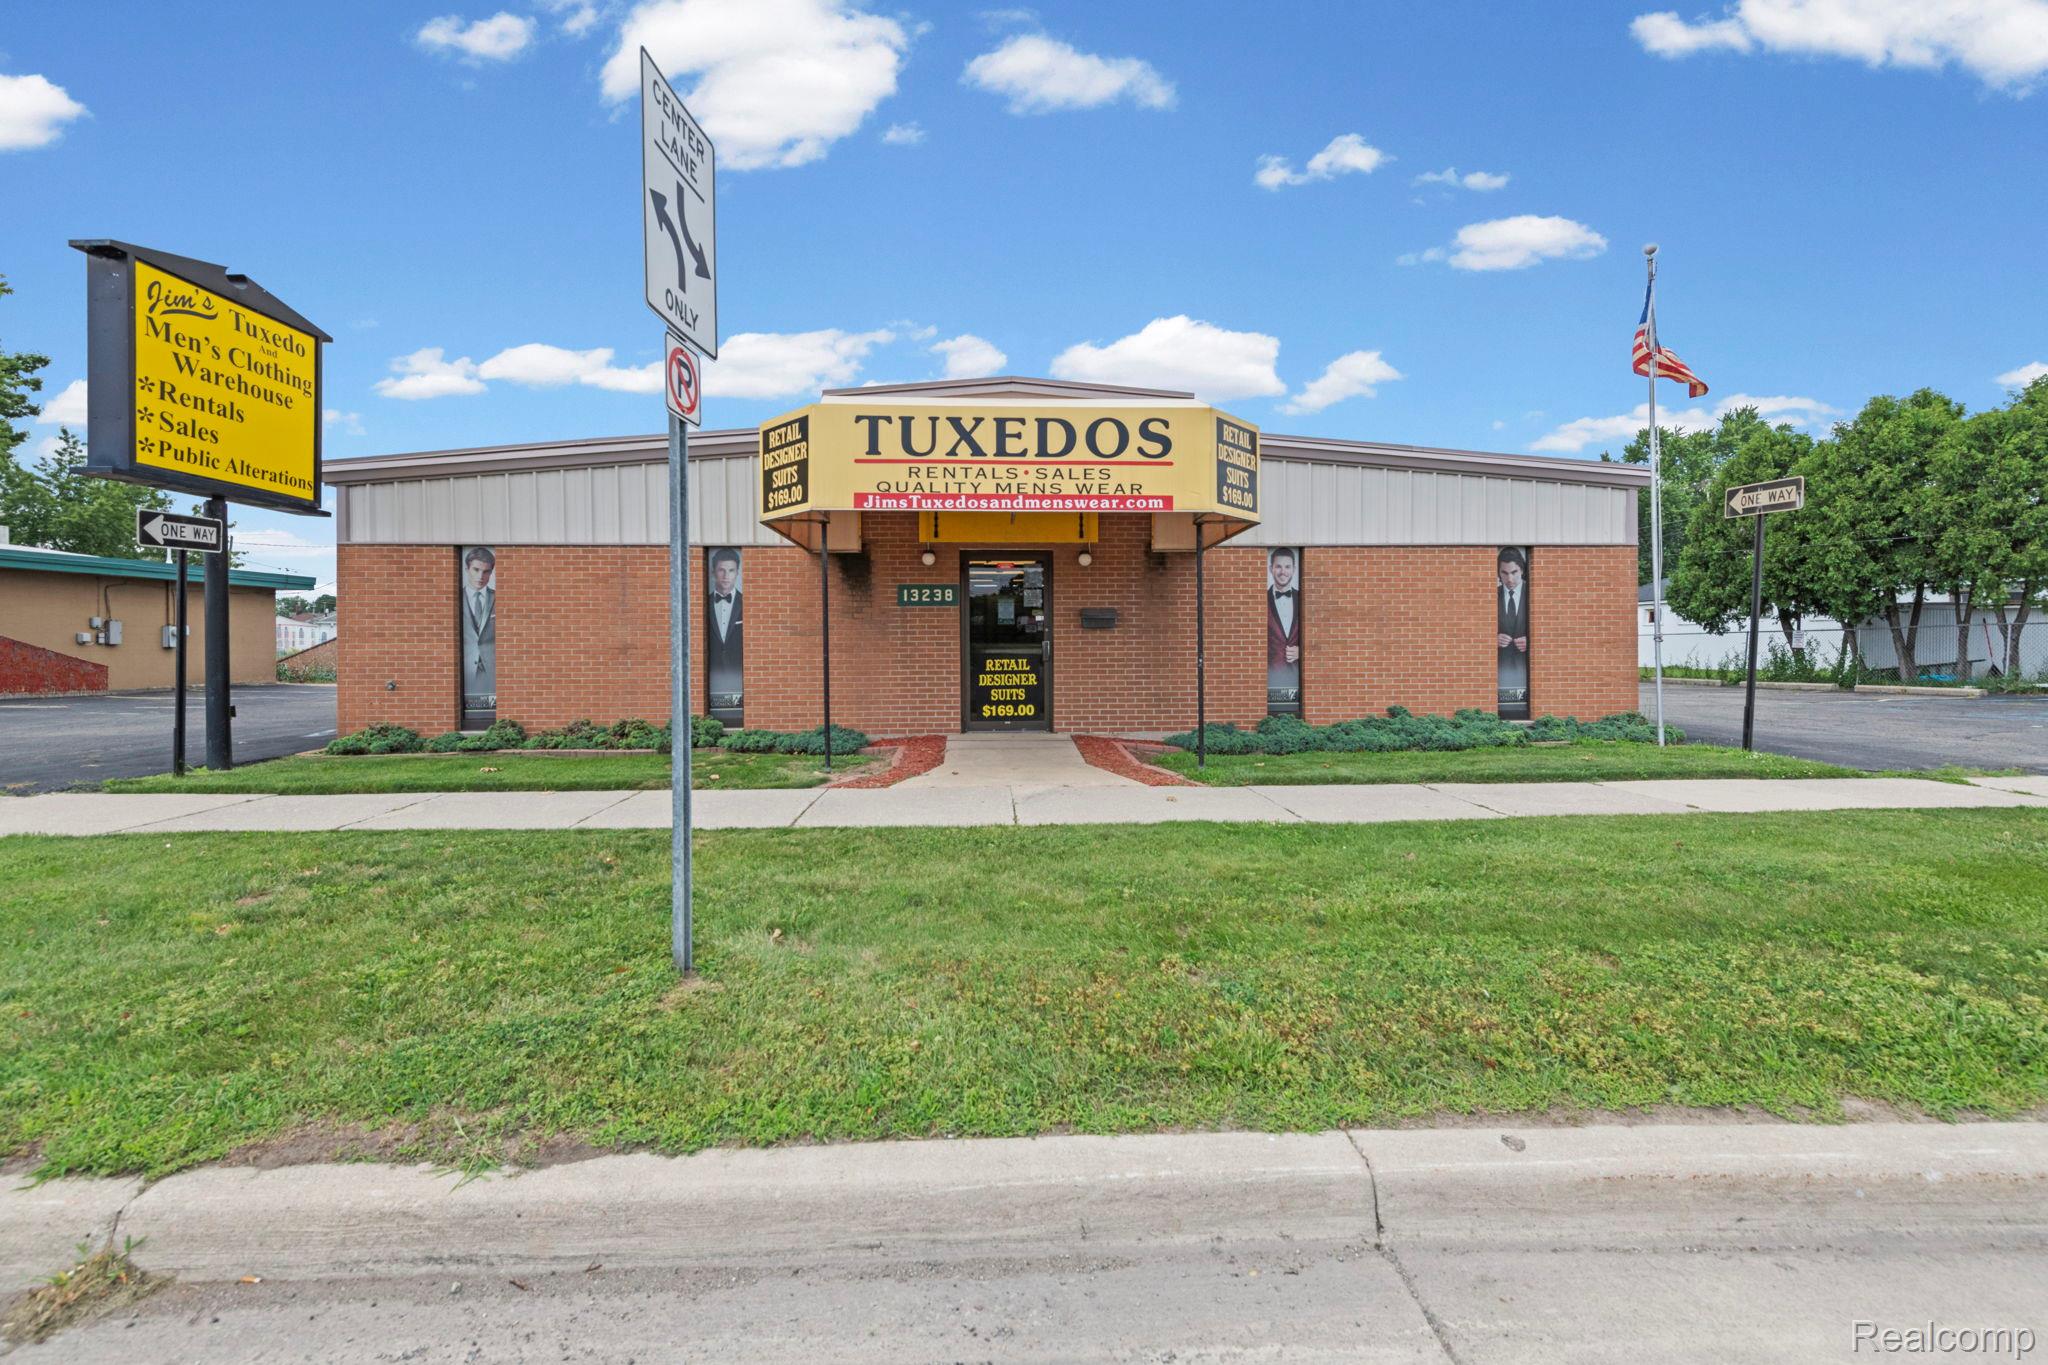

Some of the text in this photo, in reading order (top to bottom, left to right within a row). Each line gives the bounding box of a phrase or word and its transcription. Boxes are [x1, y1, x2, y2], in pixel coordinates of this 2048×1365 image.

[653, 79, 704, 164] CENTER
[661, 119, 698, 184] LANE
[147, 280, 306, 358] Jim's Tuxedo
[665, 288, 699, 332] ONLY
[145, 316, 312, 398] Men's Clothing
[258, 345, 278, 359] And
[172, 352, 293, 410] Warehouse
[159, 380, 245, 423] Rentals
[159, 410, 220, 445] Sales
[768, 422, 802, 449] RETAIL
[854, 414, 1173, 459] TUXEDOS
[1223, 423, 1252, 449] RETAIL
[159, 440, 313, 491] Public Alterations
[764, 441, 808, 471] DESIGNER
[1218, 443, 1257, 471] DESIGNER
[772, 465, 799, 488] SUITS
[908, 466, 1112, 481] RENTALS SALES
[1226, 467, 1250, 489] SUITS
[768, 484, 803, 510] $169.00
[876, 481, 1144, 495] QUALITY MENS WEAR
[1223, 485, 1253, 508] $169.00
[1740, 488, 1794, 507] ONE WAY
[863, 494, 1164, 509] JimsTuxedosandmenswear.com
[161, 523, 215, 541] ONE WAY
[903, 589, 953, 602] 13238
[985, 658, 1030, 671] RETAIL
[978, 673, 1038, 687] DESIGNER
[991, 688, 1026, 701] SUITS
[982, 704, 1035, 718] $169.00
